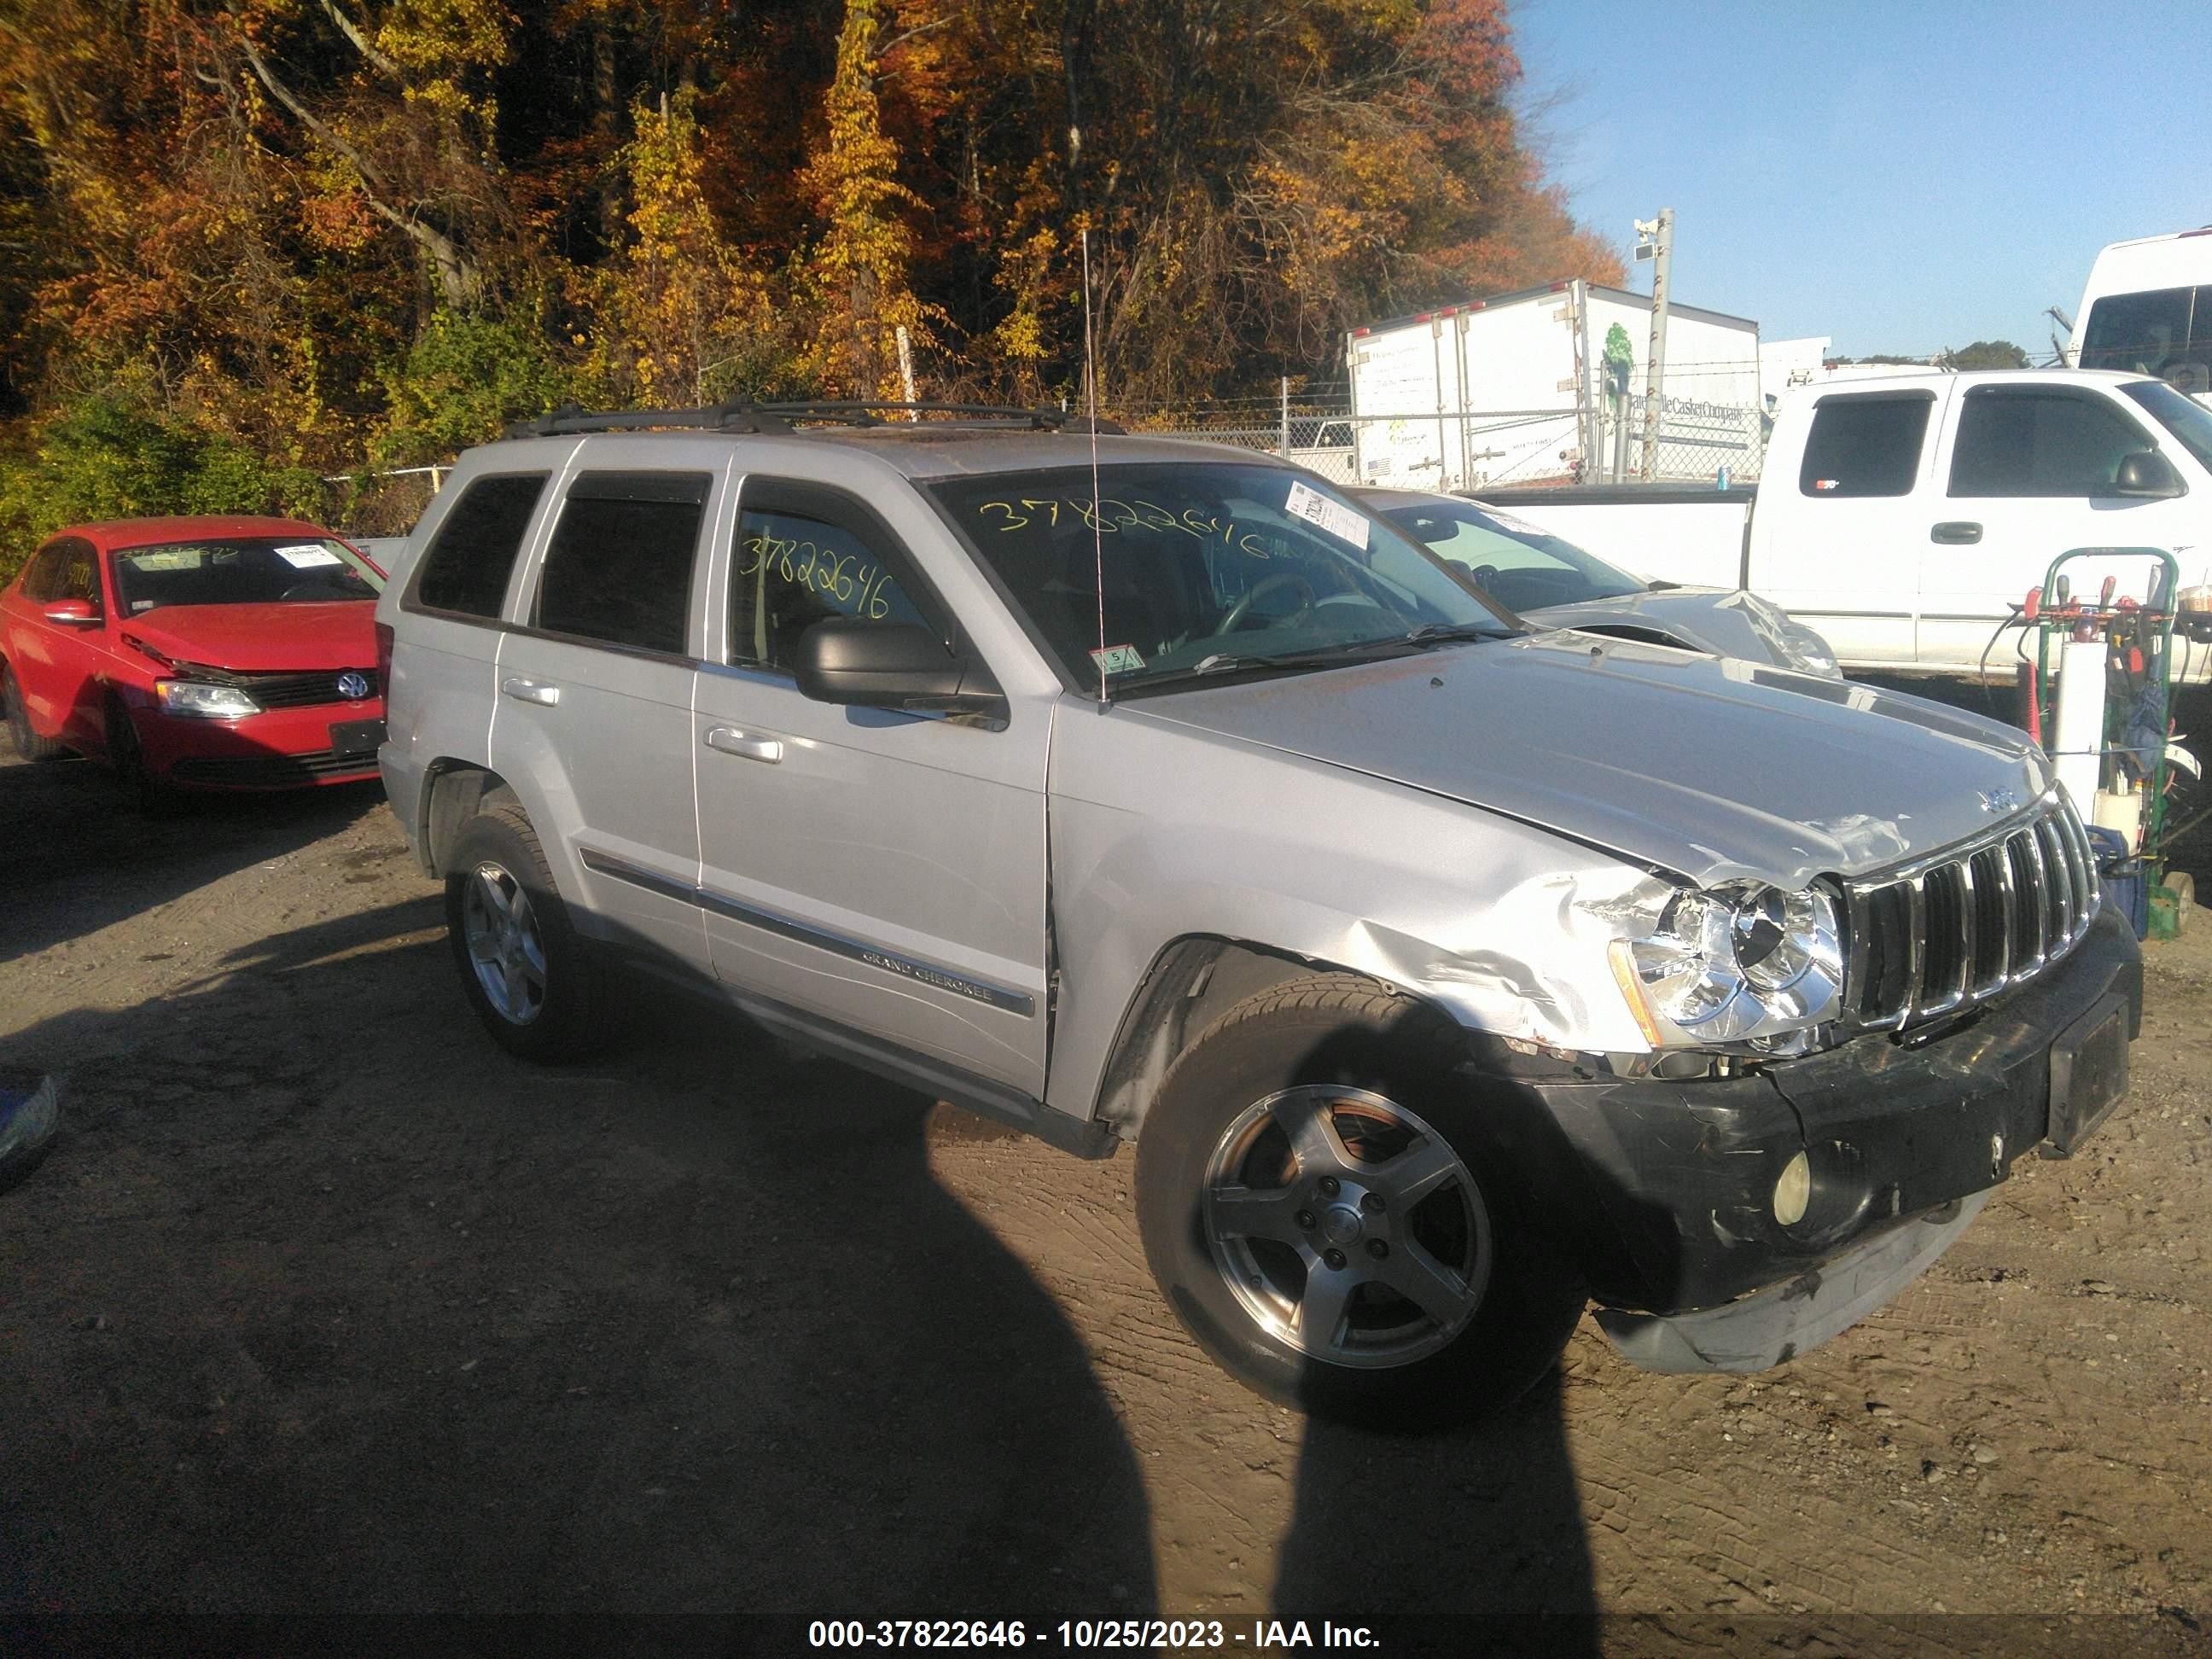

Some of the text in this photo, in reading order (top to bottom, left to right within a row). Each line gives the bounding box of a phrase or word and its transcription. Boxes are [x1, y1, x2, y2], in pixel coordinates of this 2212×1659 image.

[1672, 397, 1703, 417] Casket
[1703, 400, 1742, 425] Company
[980, 498, 1269, 560] 37822646
[739, 535, 894, 620] 37822646
[1111, 652, 1121, 661] 5
[862, 951, 993, 1002] GRAND CHEROKEE
